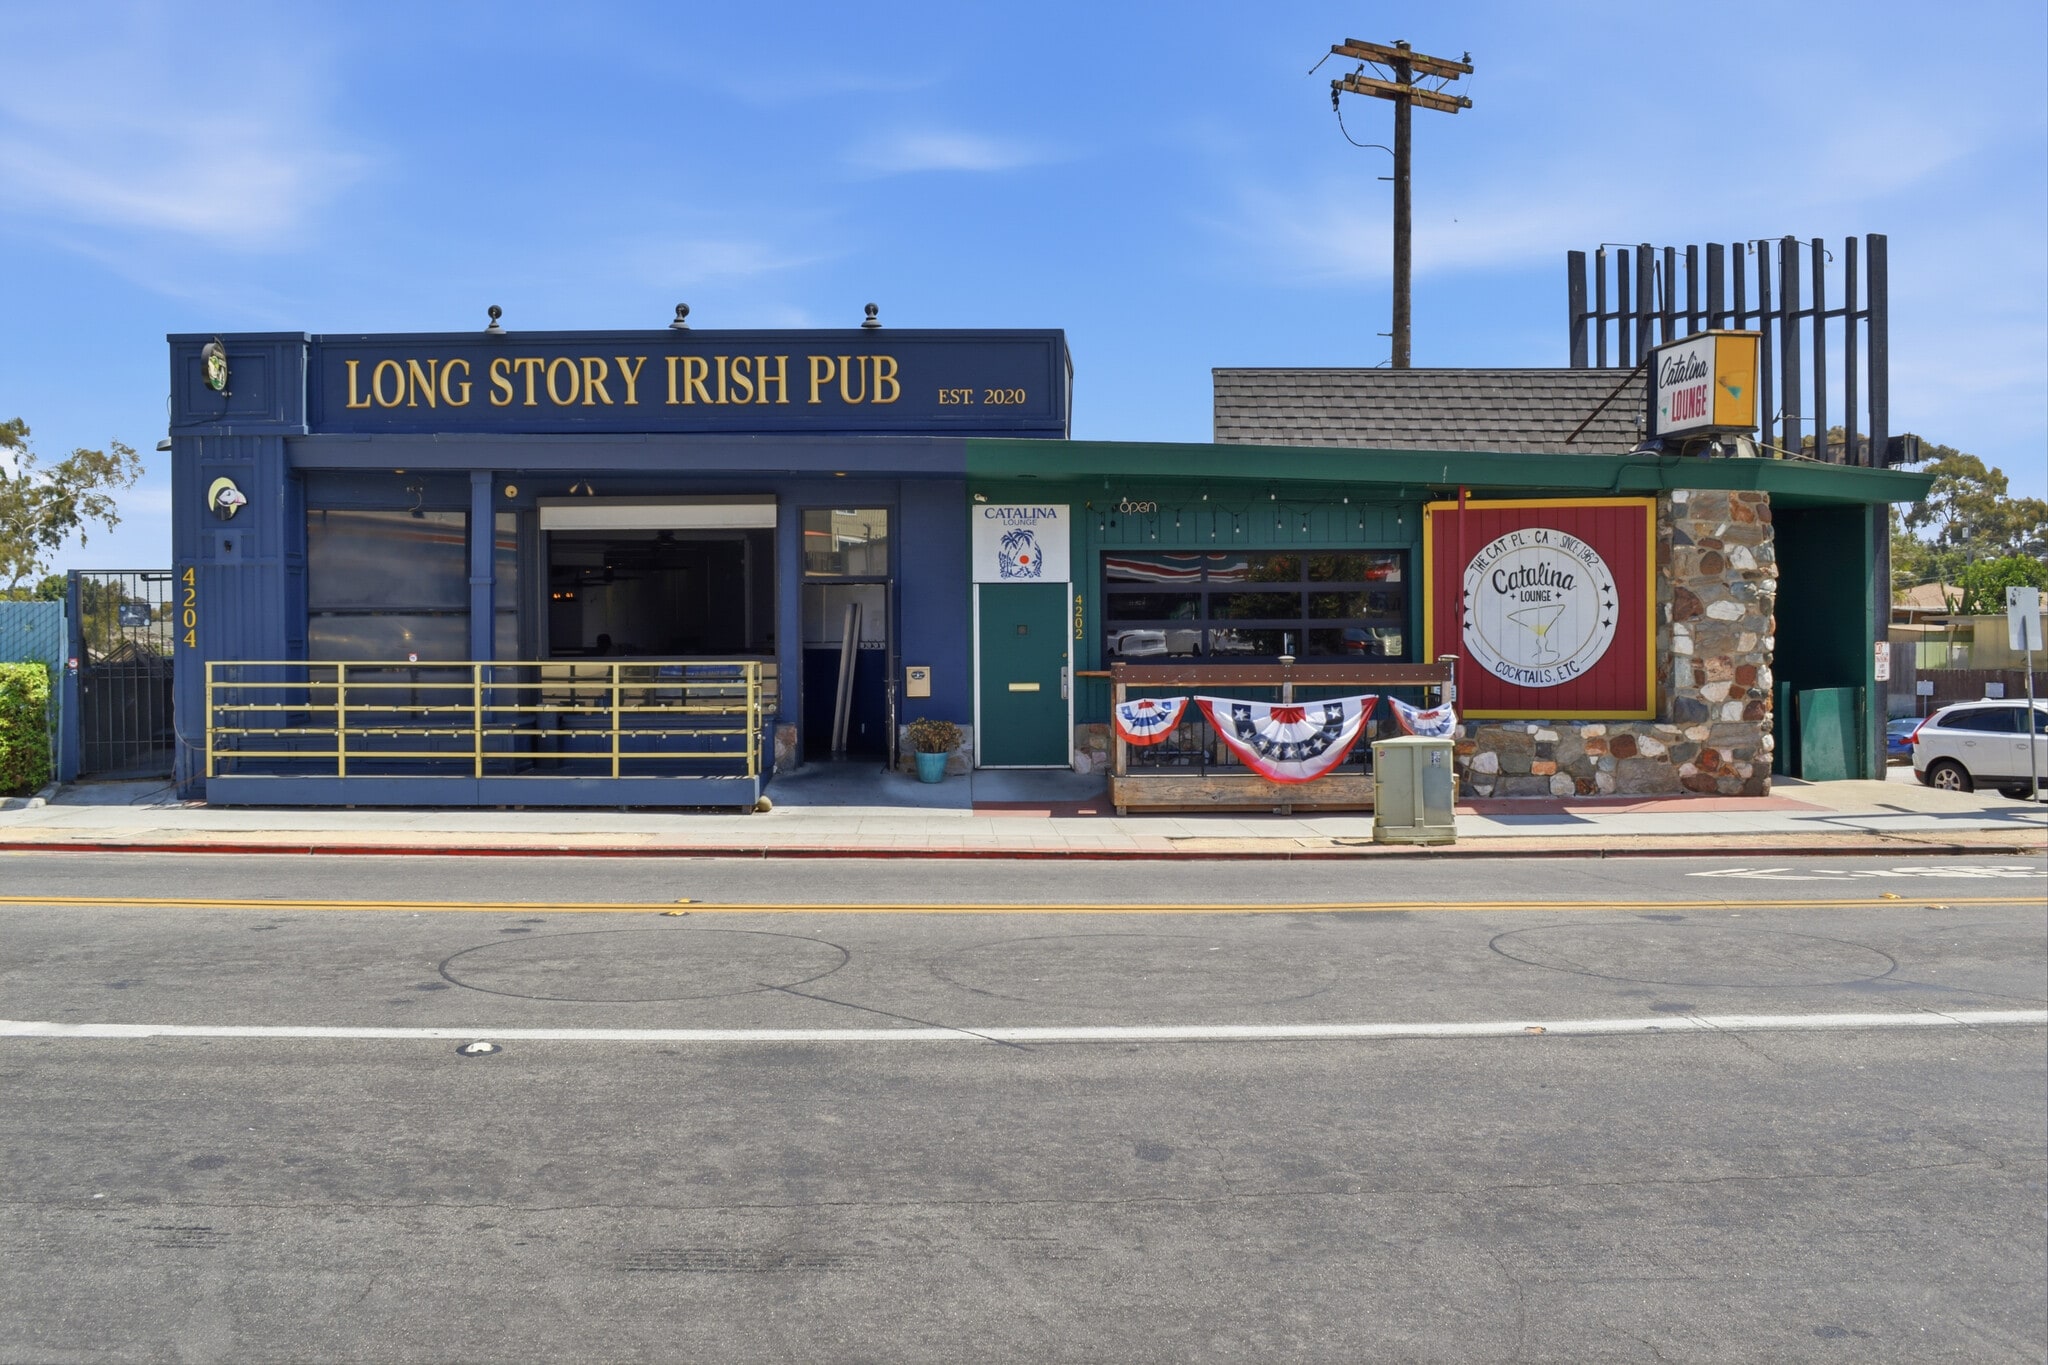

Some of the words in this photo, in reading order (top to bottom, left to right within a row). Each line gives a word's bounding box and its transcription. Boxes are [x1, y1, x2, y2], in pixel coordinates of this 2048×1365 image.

[345, 358, 472, 408] LONG
[489, 356, 648, 406] STORY
[664, 355, 789, 405] IRISH
[807, 355, 901, 405] PUB
[1659, 350, 1709, 389] Catalina
[938, 388, 974, 405] EST.
[983, 388, 1026, 405] 2020
[1671, 384, 1708, 422] LOUNGE
[984, 507, 1057, 519] CATALINA
[1003, 518, 1037, 527] LOUNGE
[1120, 501, 1157, 516] open
[1469, 554, 1490, 575] THE
[1486, 538, 1508, 560] CAT
[1534, 530, 1549, 544] CA
[1559, 535, 1581, 554] SINCE
[1576, 546, 1600, 568] 1962
[1492, 562, 1577, 594] Catalina
[182, 567, 197, 649] 4204
[1520, 590, 1552, 602] LOUNGE
[1075, 594, 1083, 640] 4202
[1557, 660, 1581, 681] ETC
